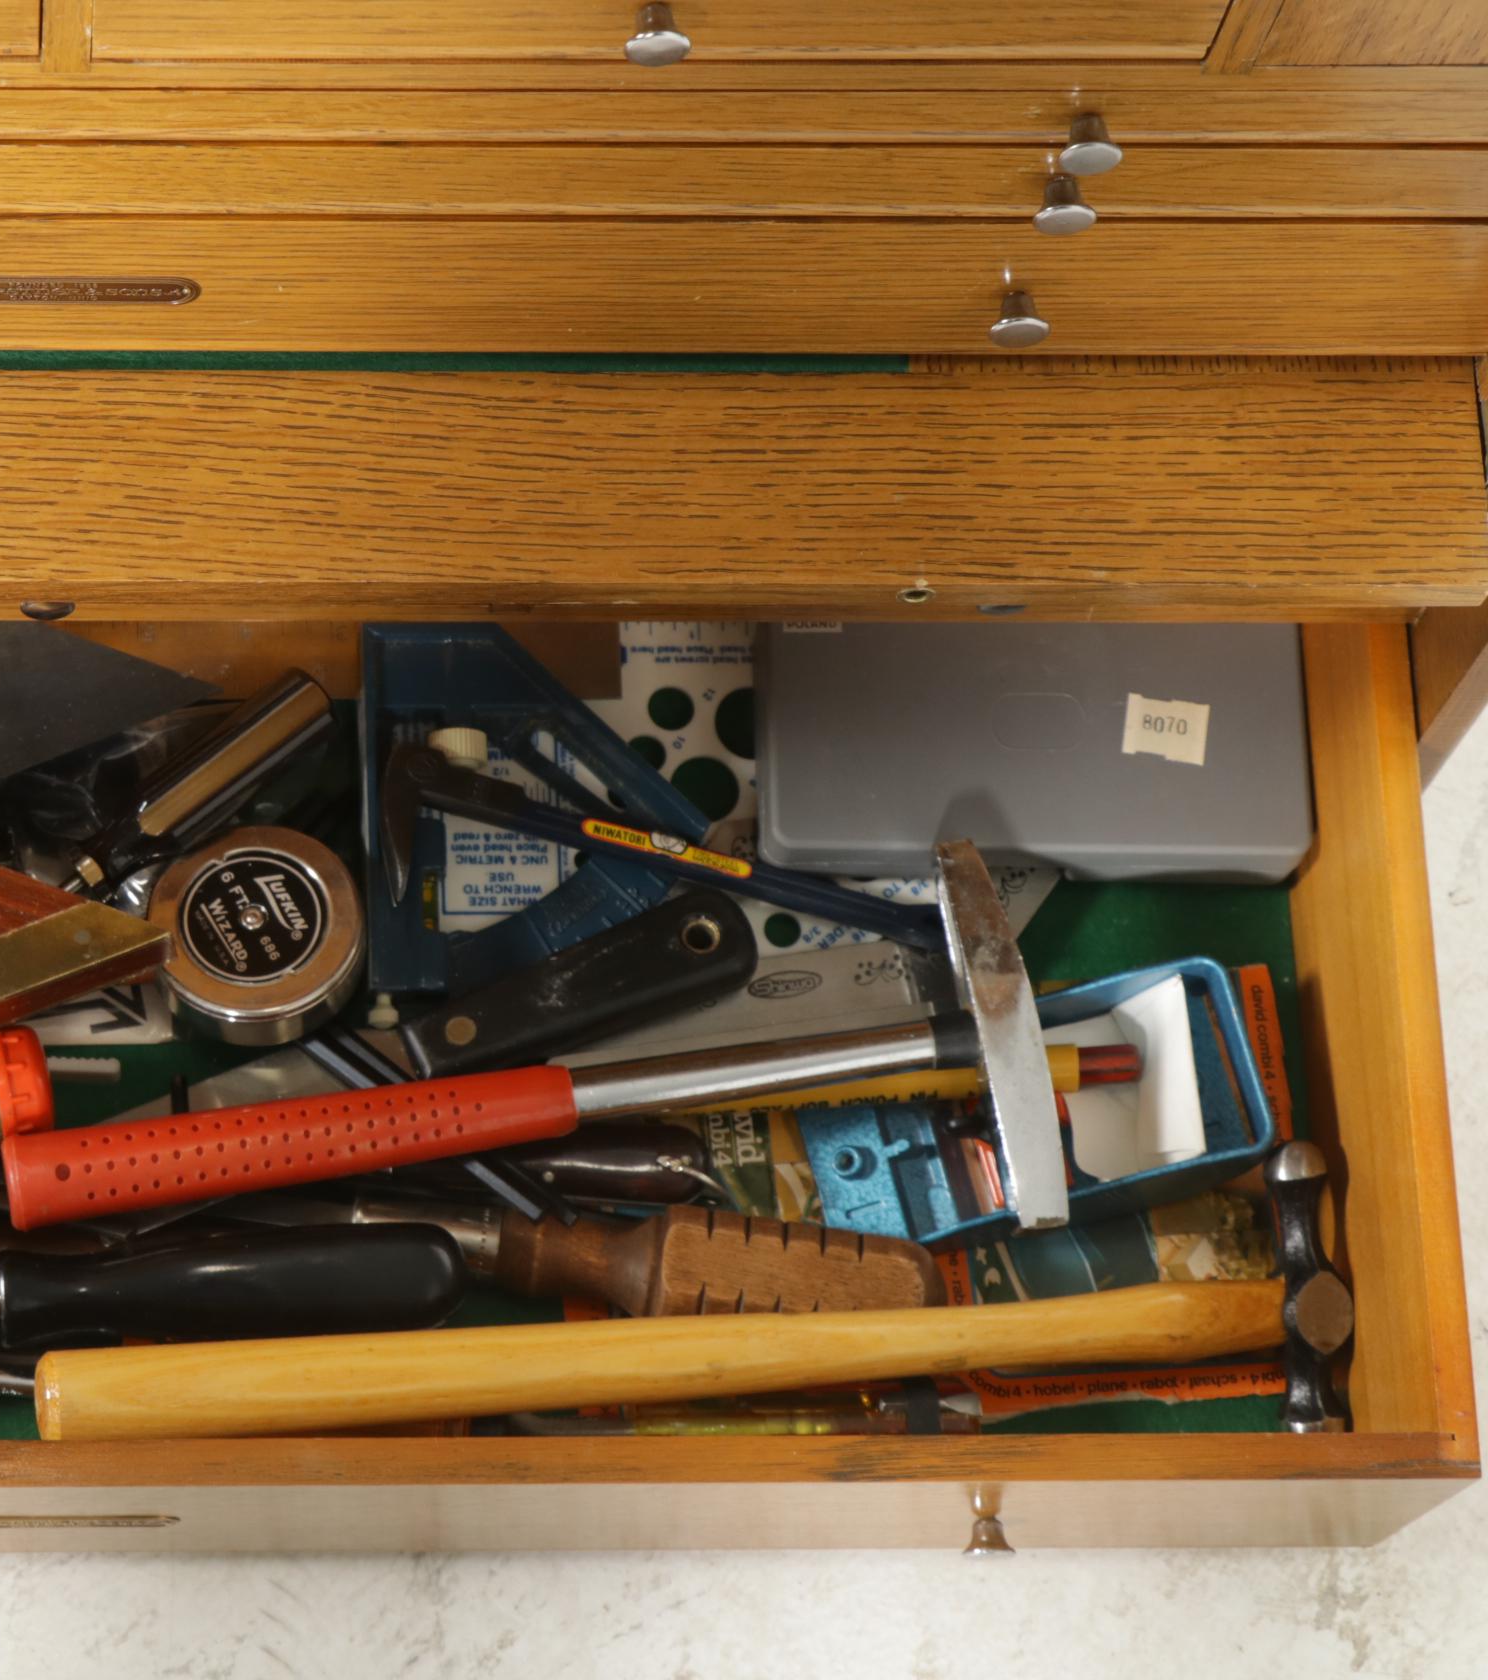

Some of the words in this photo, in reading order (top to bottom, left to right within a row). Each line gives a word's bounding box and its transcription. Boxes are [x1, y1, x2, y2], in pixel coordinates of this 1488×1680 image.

[1142, 714, 1188, 735] 8070
[592, 823, 647, 846] NIWATORI
[483, 843, 513, 852] head
[455, 854, 505, 865] METRIC
[521, 855, 549, 865] UNC
[221, 871, 235, 883] 6
[488, 871, 515, 882] USE
[463, 884, 481, 895] TO
[484, 884, 542, 894] WRENCH
[468, 896, 497, 907] SIZE
[1251, 984, 1268, 1021] david
[1256, 1024, 1273, 1063] combi
[733, 1113, 767, 1166] vid
[1033, 1380, 1077, 1397] hobel
[1086, 1380, 1129, 1396] plane
[1139, 1375, 1179, 1391] rabot
